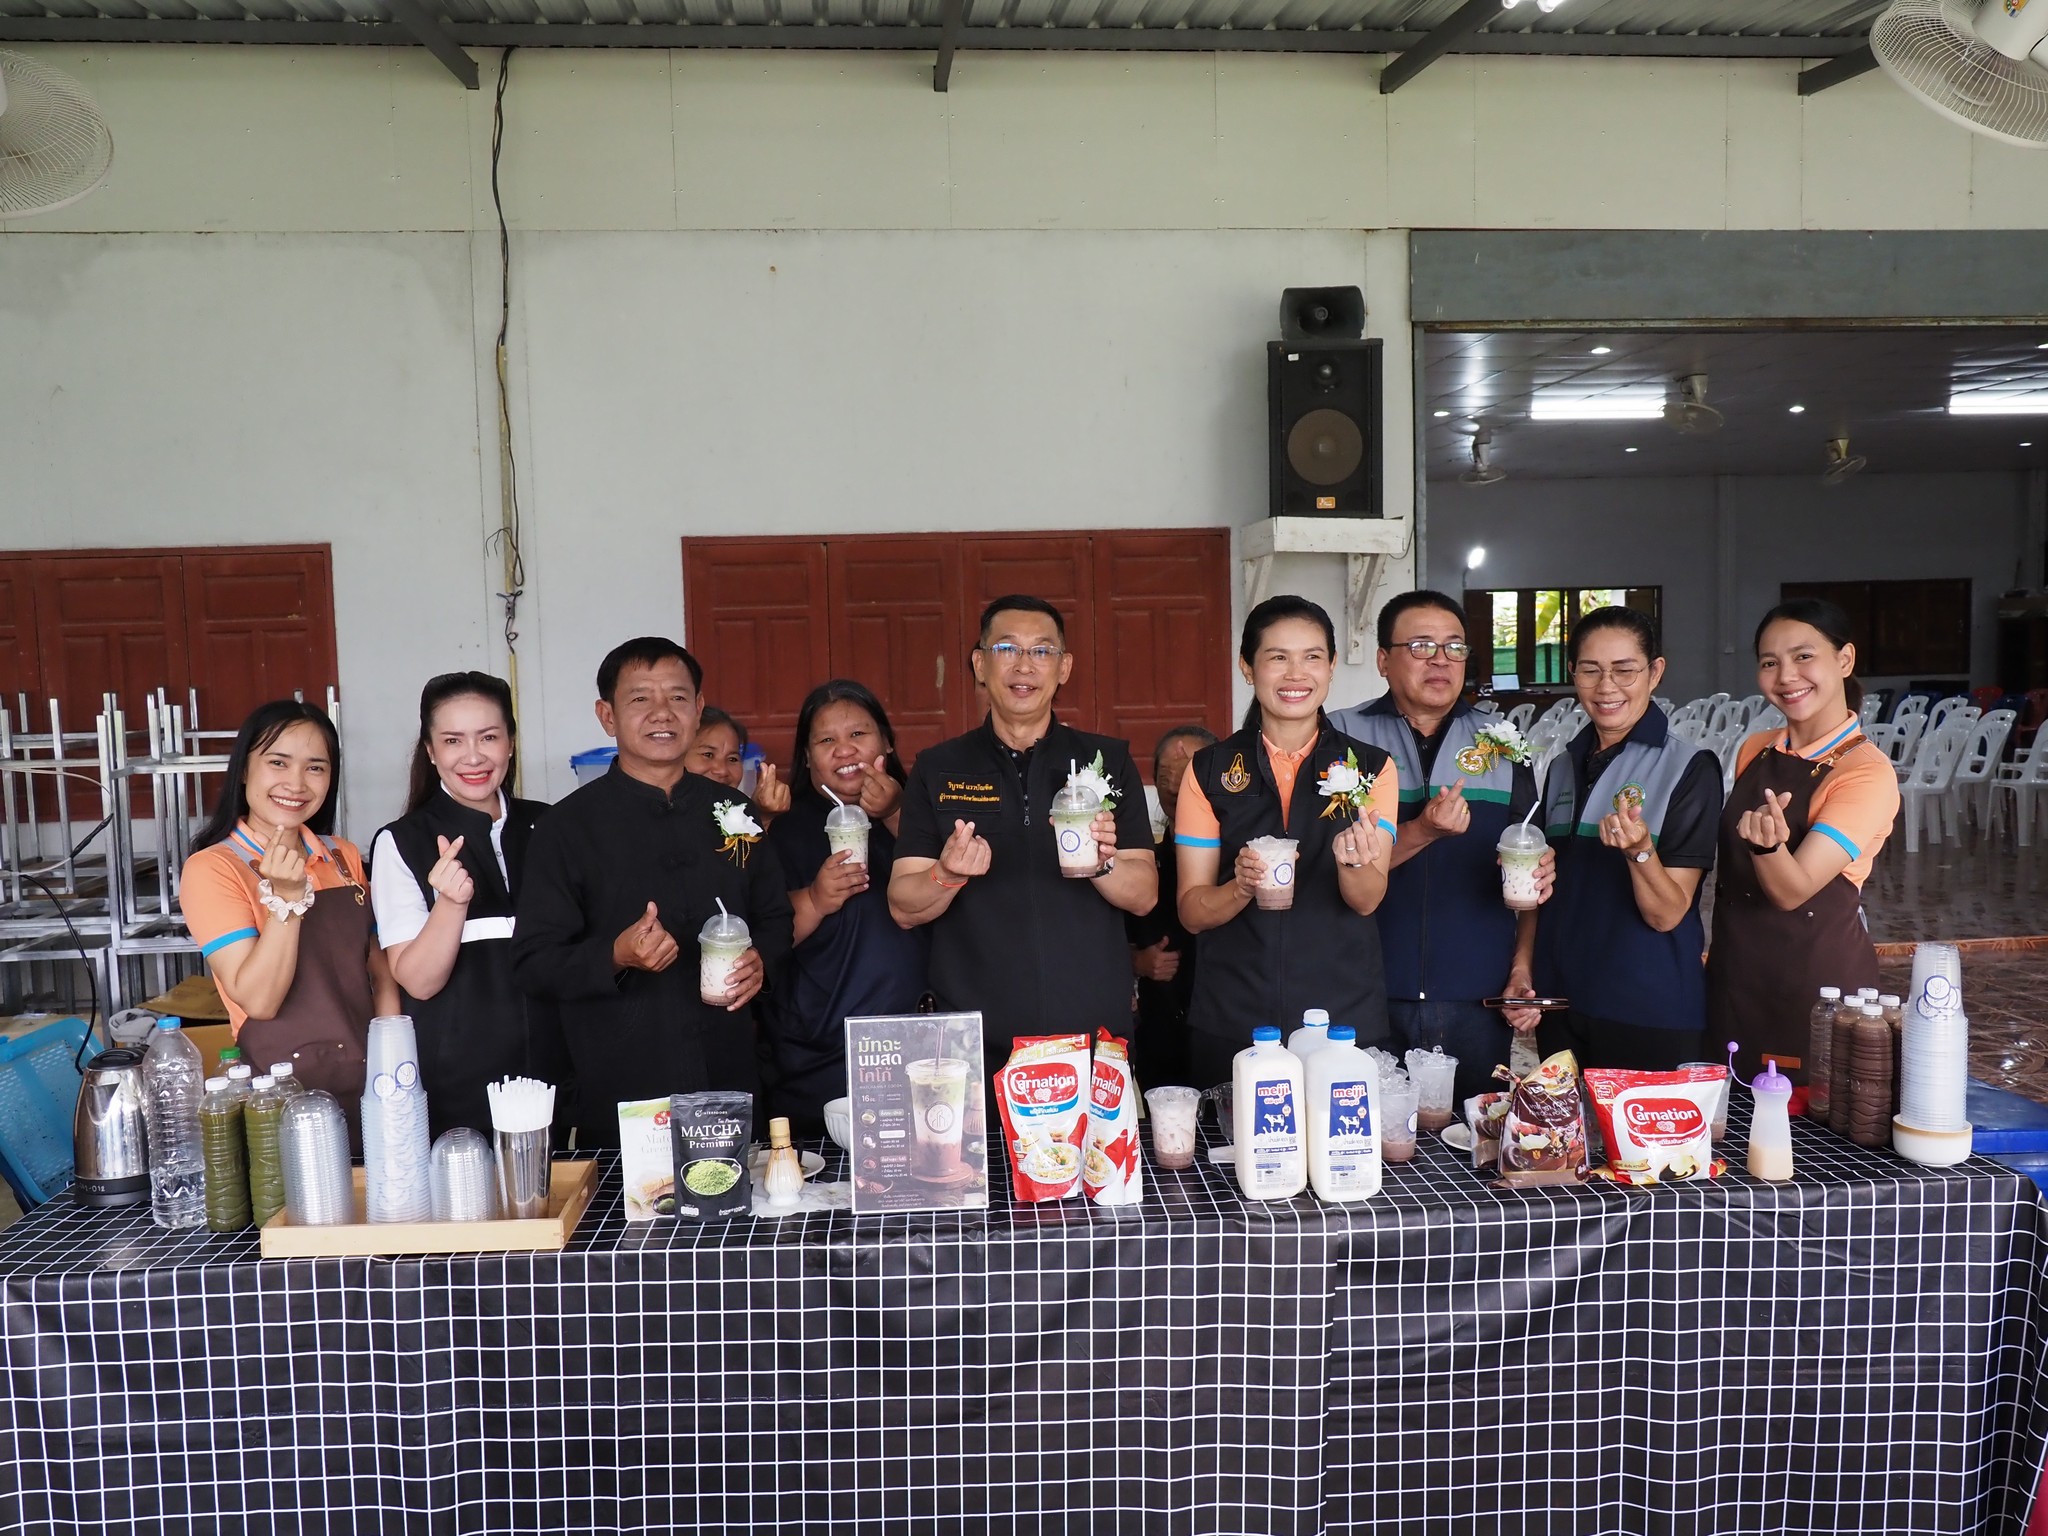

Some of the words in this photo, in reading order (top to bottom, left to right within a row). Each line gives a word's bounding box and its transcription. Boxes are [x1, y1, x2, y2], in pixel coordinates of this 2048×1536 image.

[858, 1036, 901, 1053] มัทฉะ
[858, 1053, 902, 1067] นมสด
[859, 1066, 892, 1083] โกโก้
[1010, 1071, 1076, 1095] Carnation
[1259, 1084, 1288, 1097] meiji
[1334, 1086, 1364, 1098] meiji
[1626, 1103, 1699, 1126] Carnation
[681, 1124, 742, 1138] MATCHA
[689, 1139, 734, 1149] Premium
